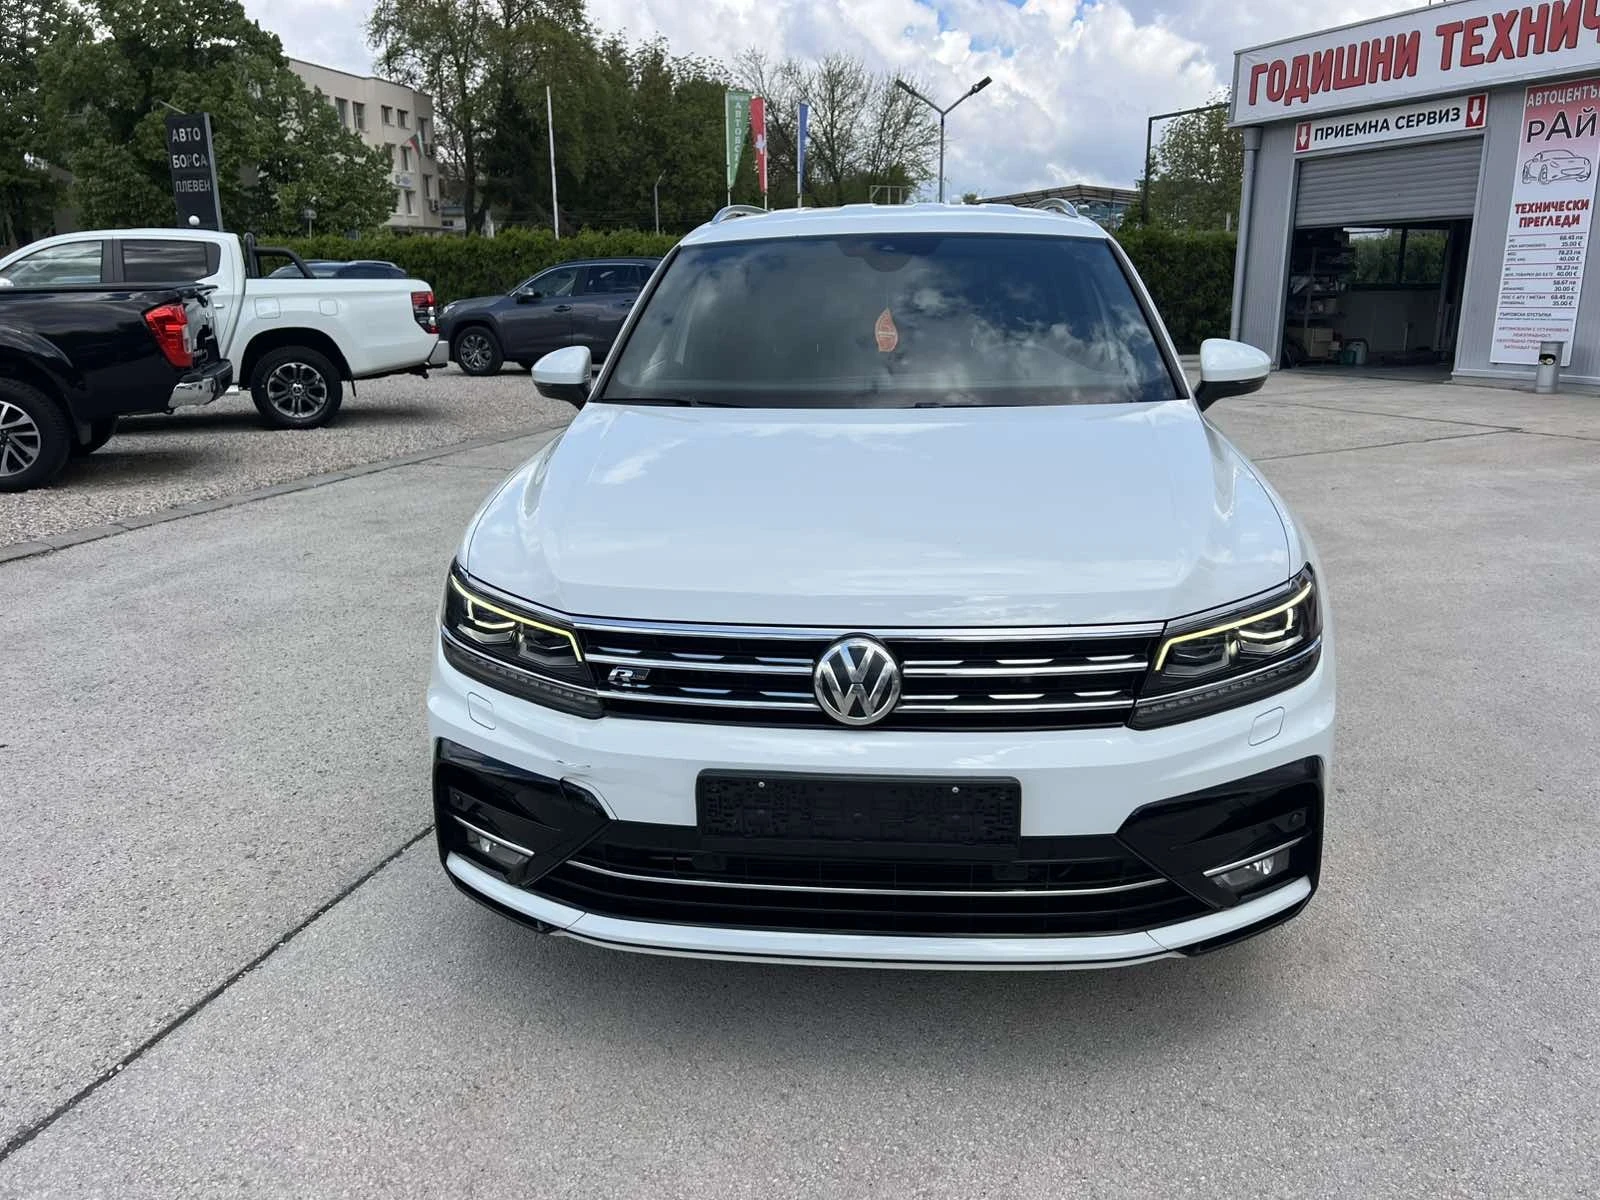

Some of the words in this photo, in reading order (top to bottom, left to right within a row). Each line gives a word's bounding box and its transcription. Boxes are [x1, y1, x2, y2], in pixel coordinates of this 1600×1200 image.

[1248, 31, 1421, 106] ГОДИШНИ
[1526, 85, 1600, 108] АВТОЦЕНТЪ
[1314, 118, 1390, 141] ПРИЕМНА
[1395, 107, 1460, 130] СЕРВИЗ
[1526, 106, 1597, 143] РАЙ
[172, 127, 201, 142] АВТО
[172, 153, 208, 168] БОРСА
[175, 179, 210, 192] ПЛЕВЕН
[1515, 199, 1590, 215] ТЕХНИЧЕСКИ
[1518, 214, 1581, 229] ПРЕГЛЕДИ
